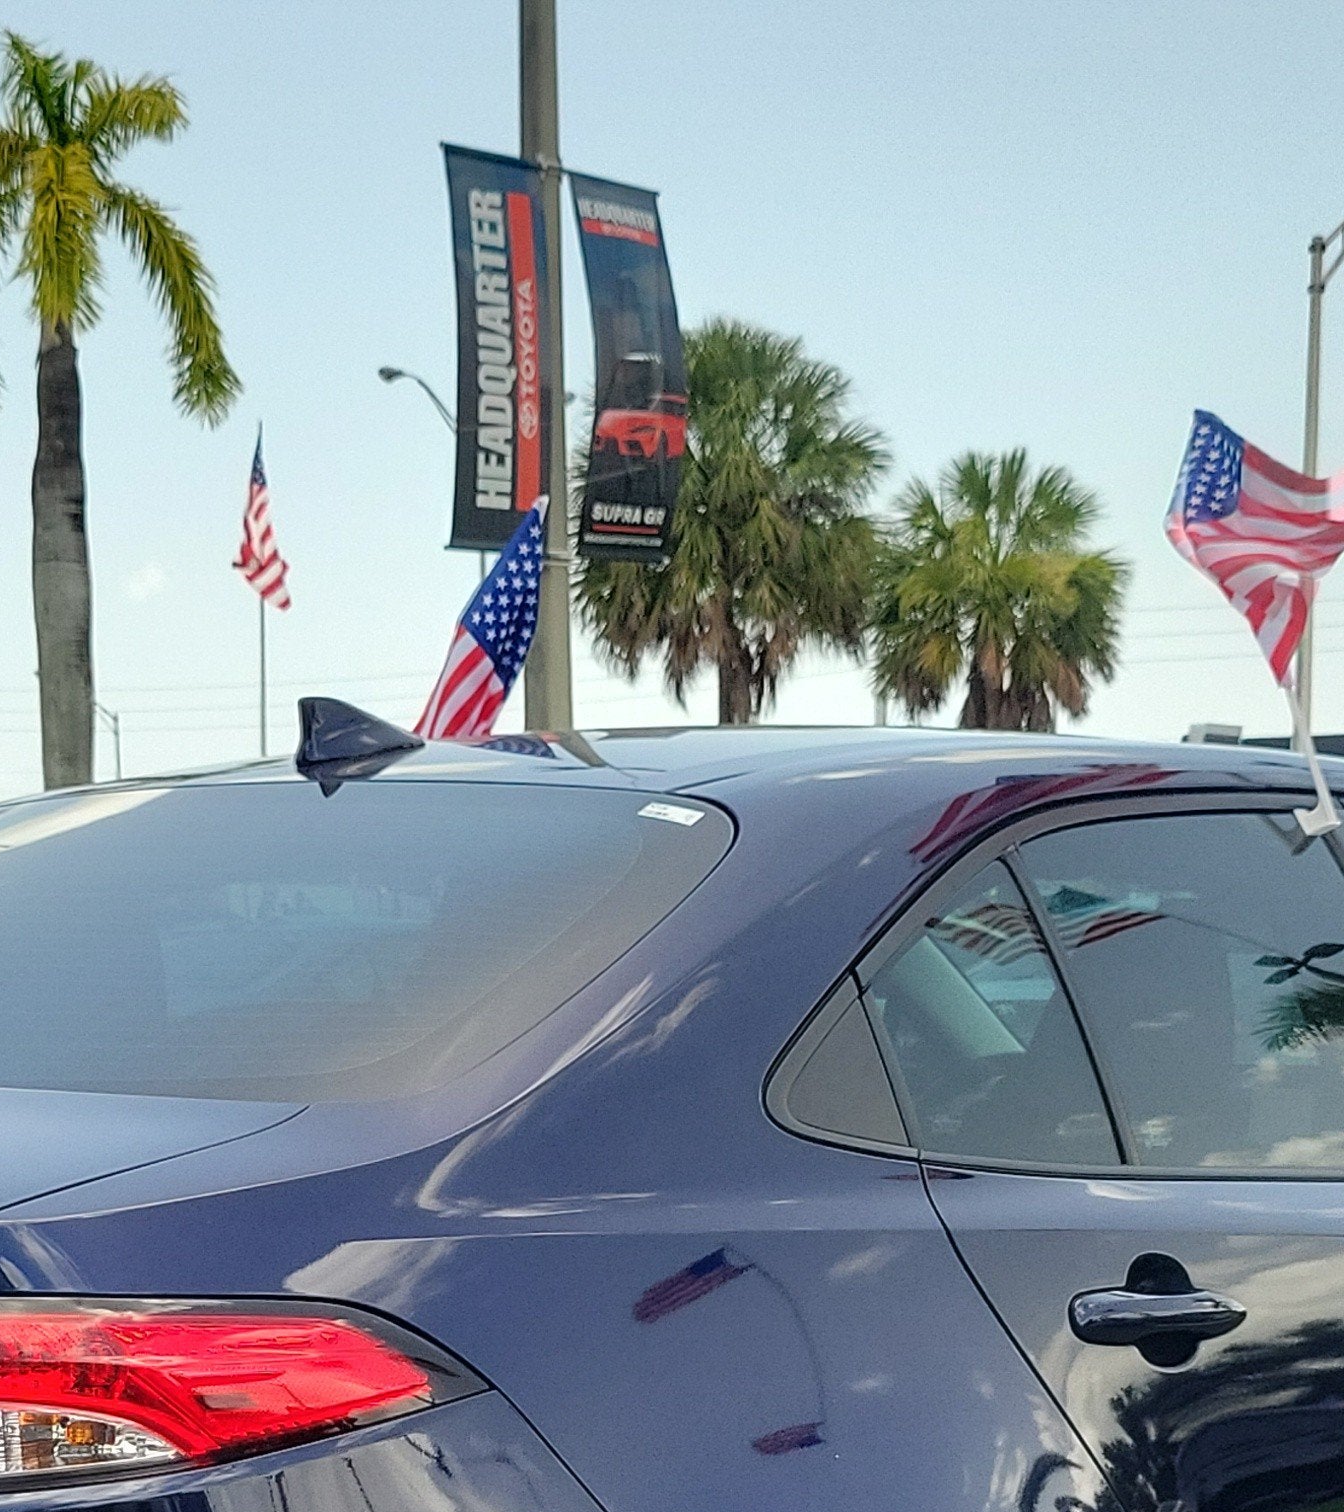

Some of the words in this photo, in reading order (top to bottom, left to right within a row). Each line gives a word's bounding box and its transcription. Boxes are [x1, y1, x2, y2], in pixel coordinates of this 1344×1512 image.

[468, 187, 518, 511] HEADQUARTER
[515, 278, 540, 400] TOYOTA
[591, 501, 642, 525] SUPRA
[643, 506, 667, 526] GR
